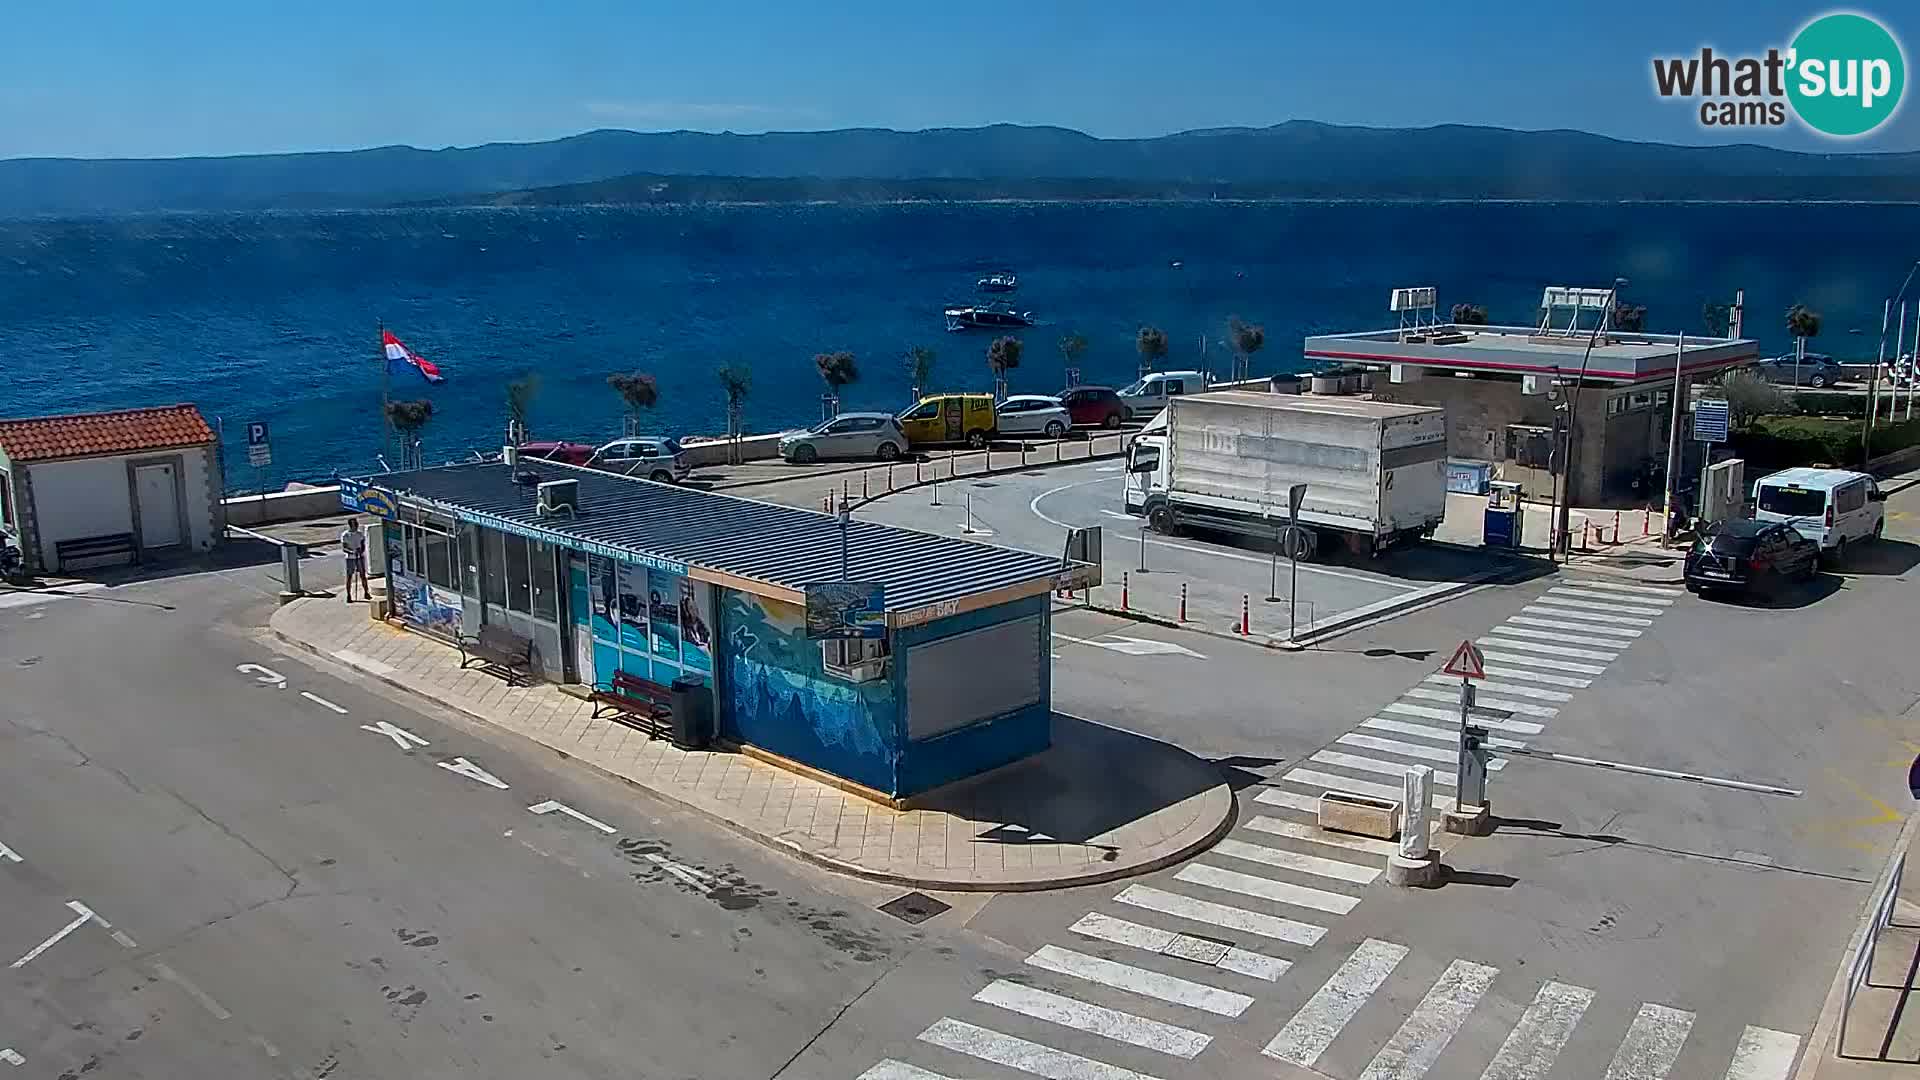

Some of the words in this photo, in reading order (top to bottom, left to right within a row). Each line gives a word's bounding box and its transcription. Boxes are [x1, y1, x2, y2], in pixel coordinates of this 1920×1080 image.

[252, 425, 263, 442] P
[504, 522, 541, 540] AUTOBUSNA
[542, 531, 572, 547] POSTAJA
[582, 541, 597, 553] BUS
[597, 545, 629, 562] STATION
[631, 553, 656, 568] TICKET
[657, 559, 684, 574] OFFICE
